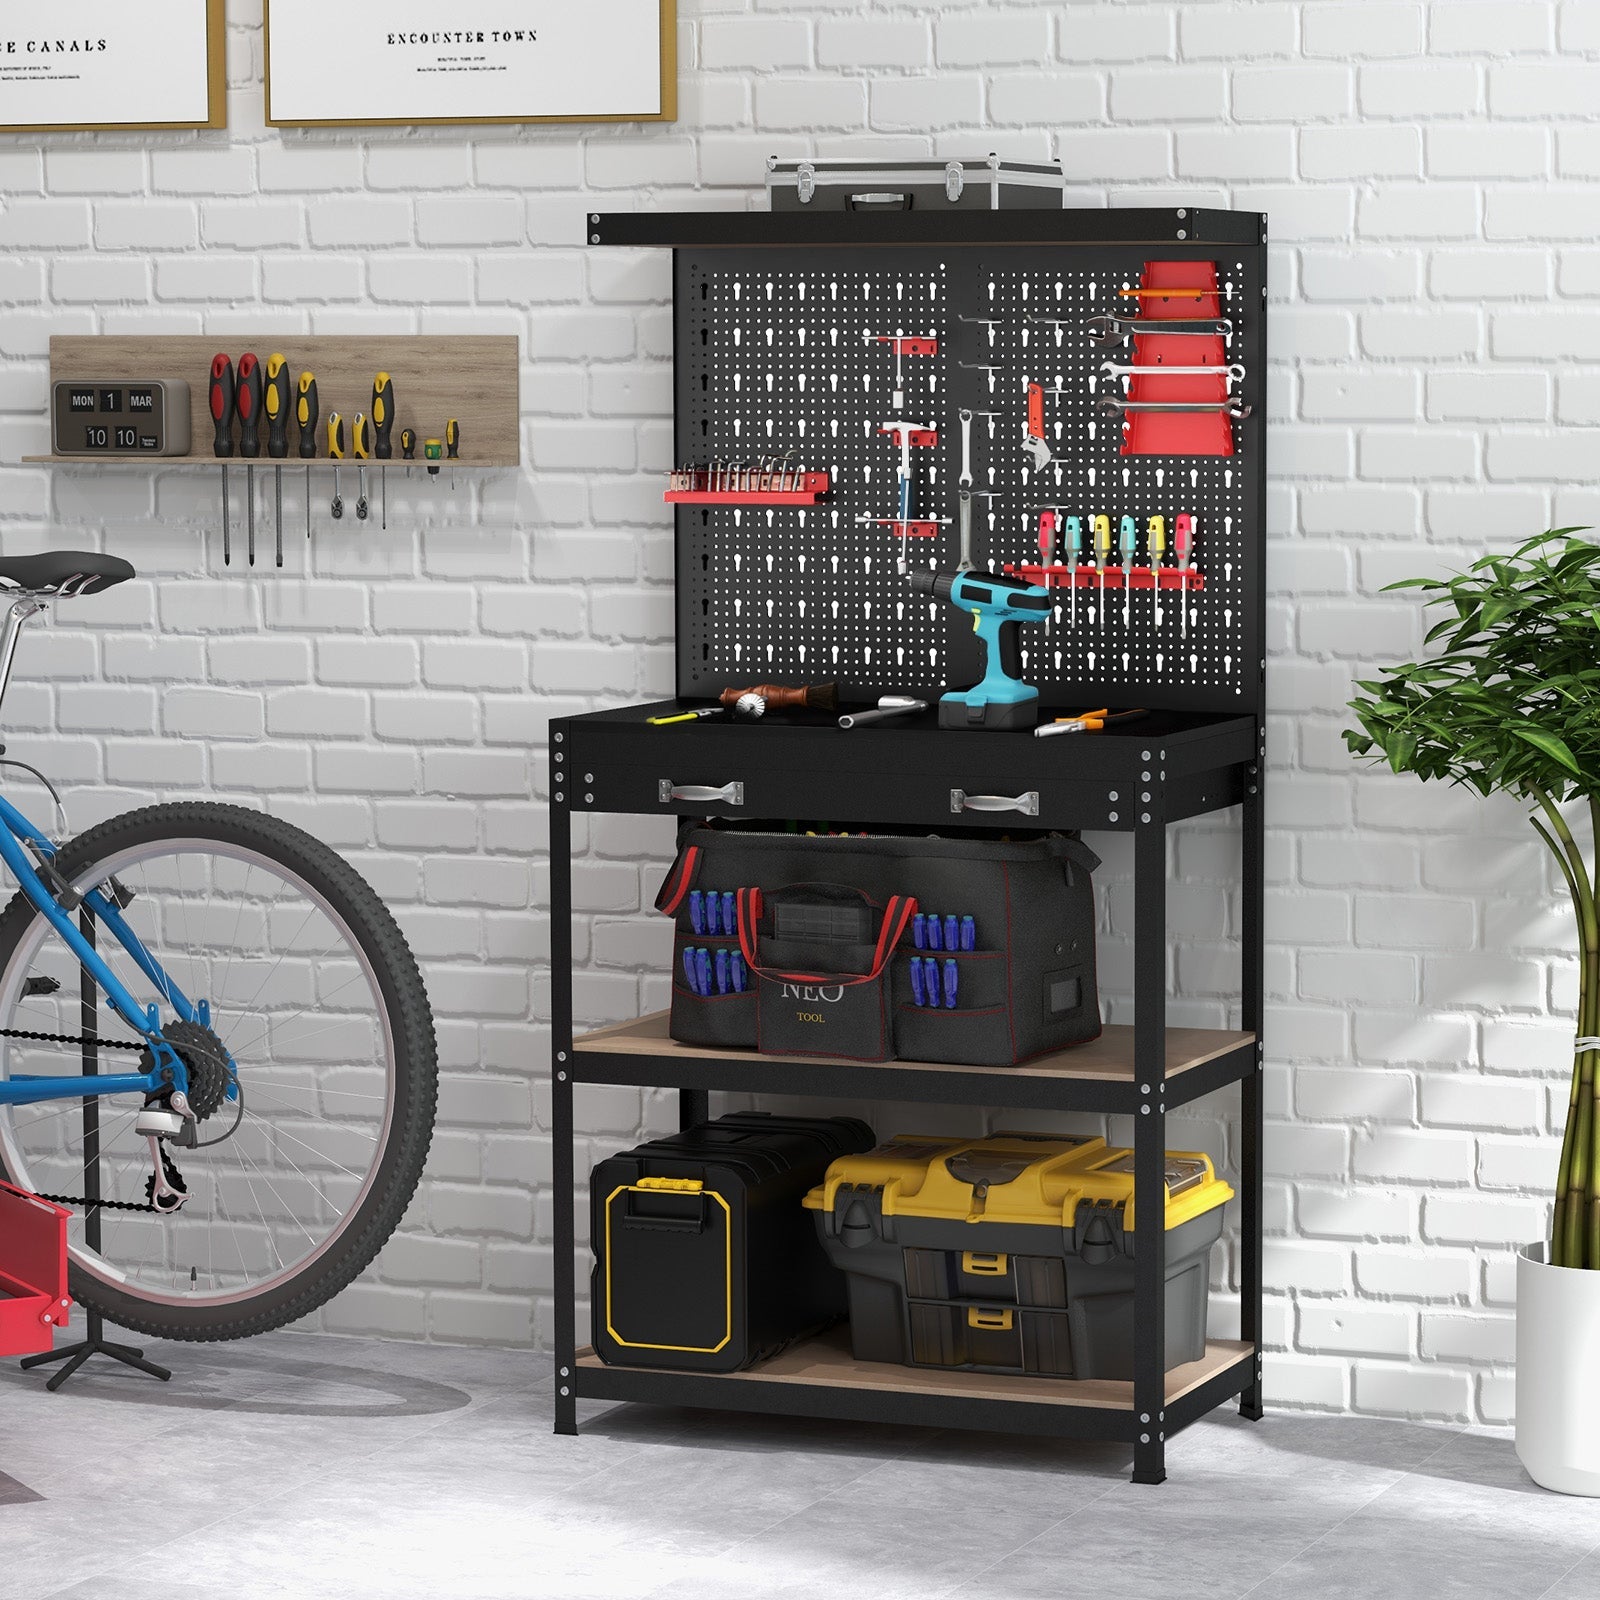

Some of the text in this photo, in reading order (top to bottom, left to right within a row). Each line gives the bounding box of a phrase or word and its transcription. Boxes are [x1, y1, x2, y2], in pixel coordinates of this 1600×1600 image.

[387, 30, 537, 45] ENCOUNTER TOWN
[26, 38, 107, 53] CANALS
[72, 393, 152, 409] MON 1 MAR
[88, 429, 135, 446] 10 10
[781, 983, 844, 1003] NEO
[796, 1011, 826, 1023] TOOL
